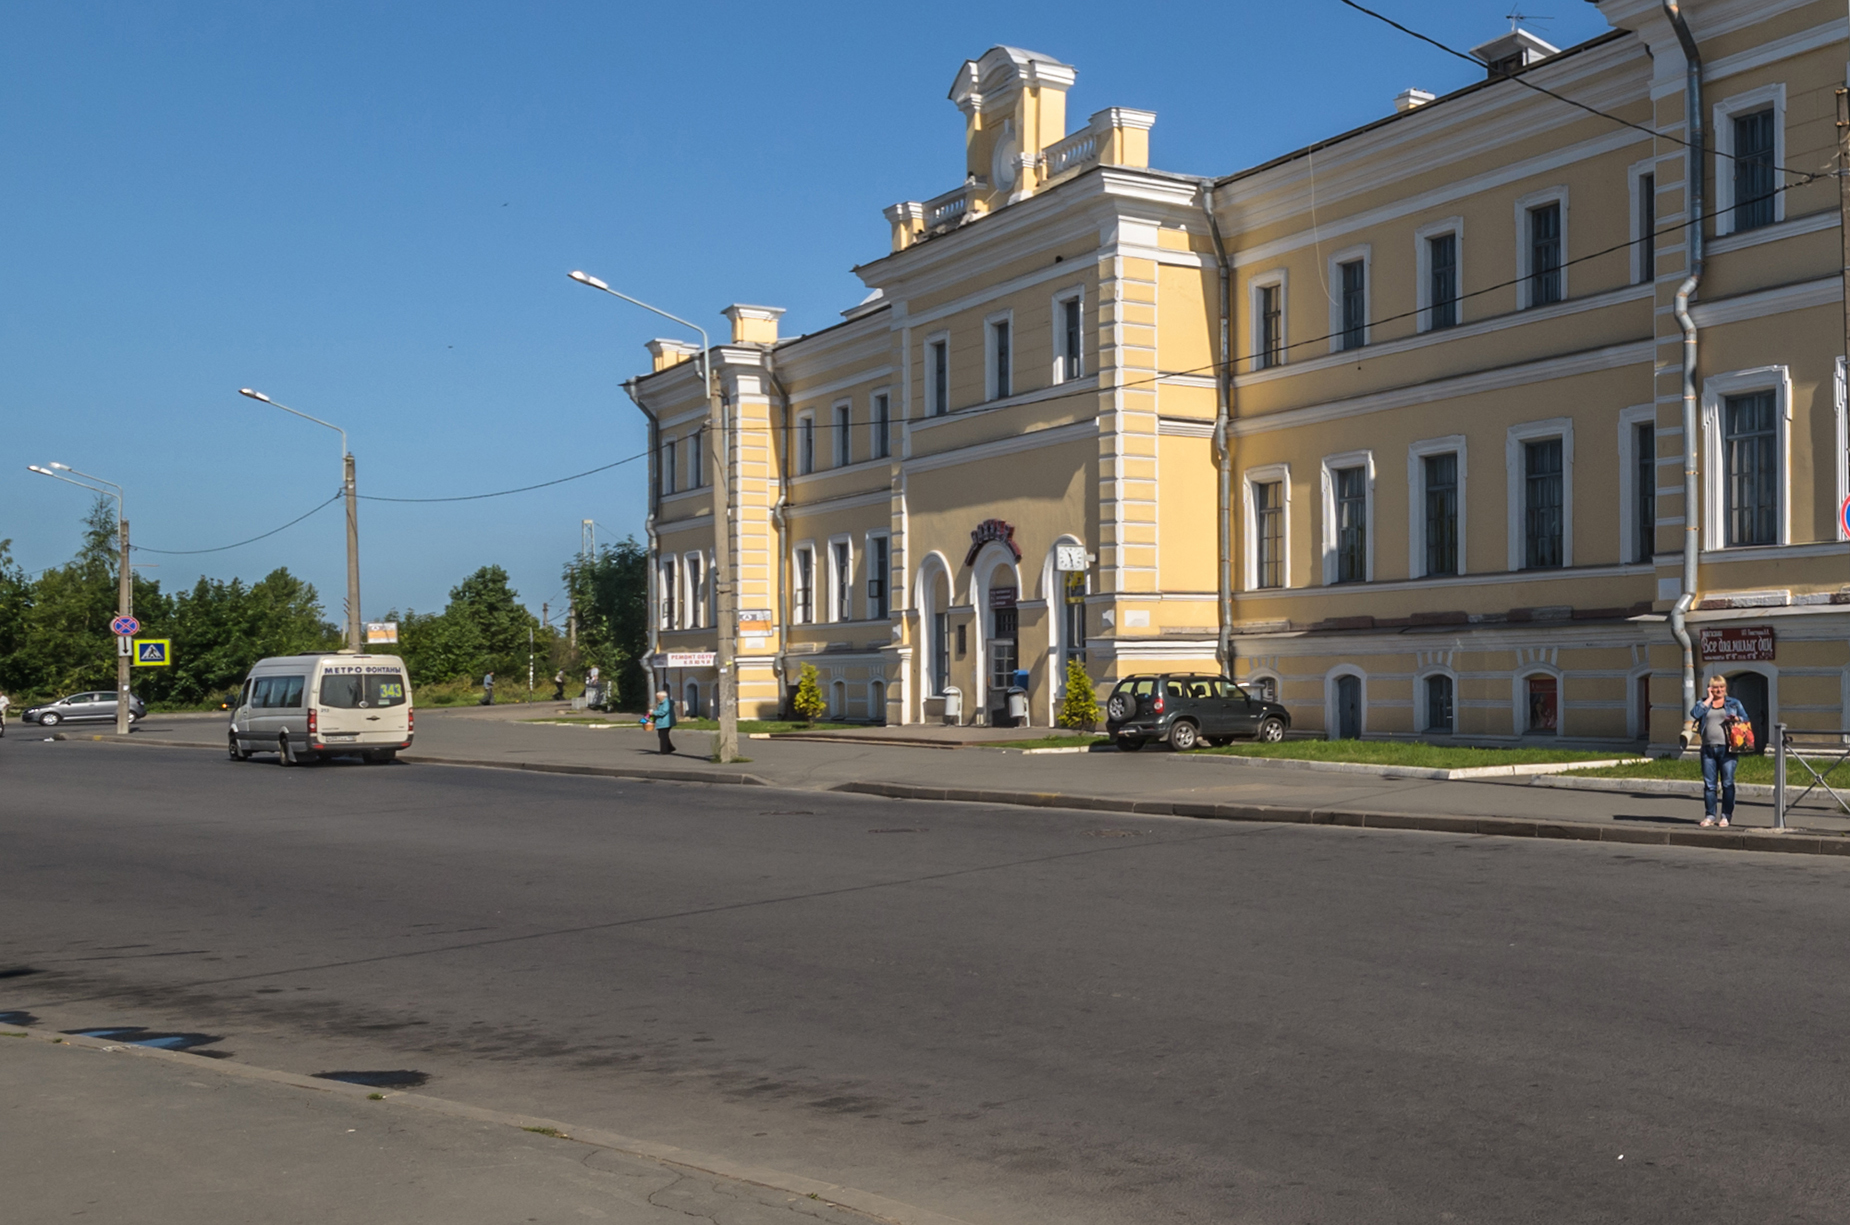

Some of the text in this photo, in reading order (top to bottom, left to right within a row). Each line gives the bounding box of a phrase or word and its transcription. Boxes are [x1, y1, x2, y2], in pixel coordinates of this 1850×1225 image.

[324, 666, 401, 674] МЕТРО ФОНТАНЫ
[380, 683, 402, 698] 343
